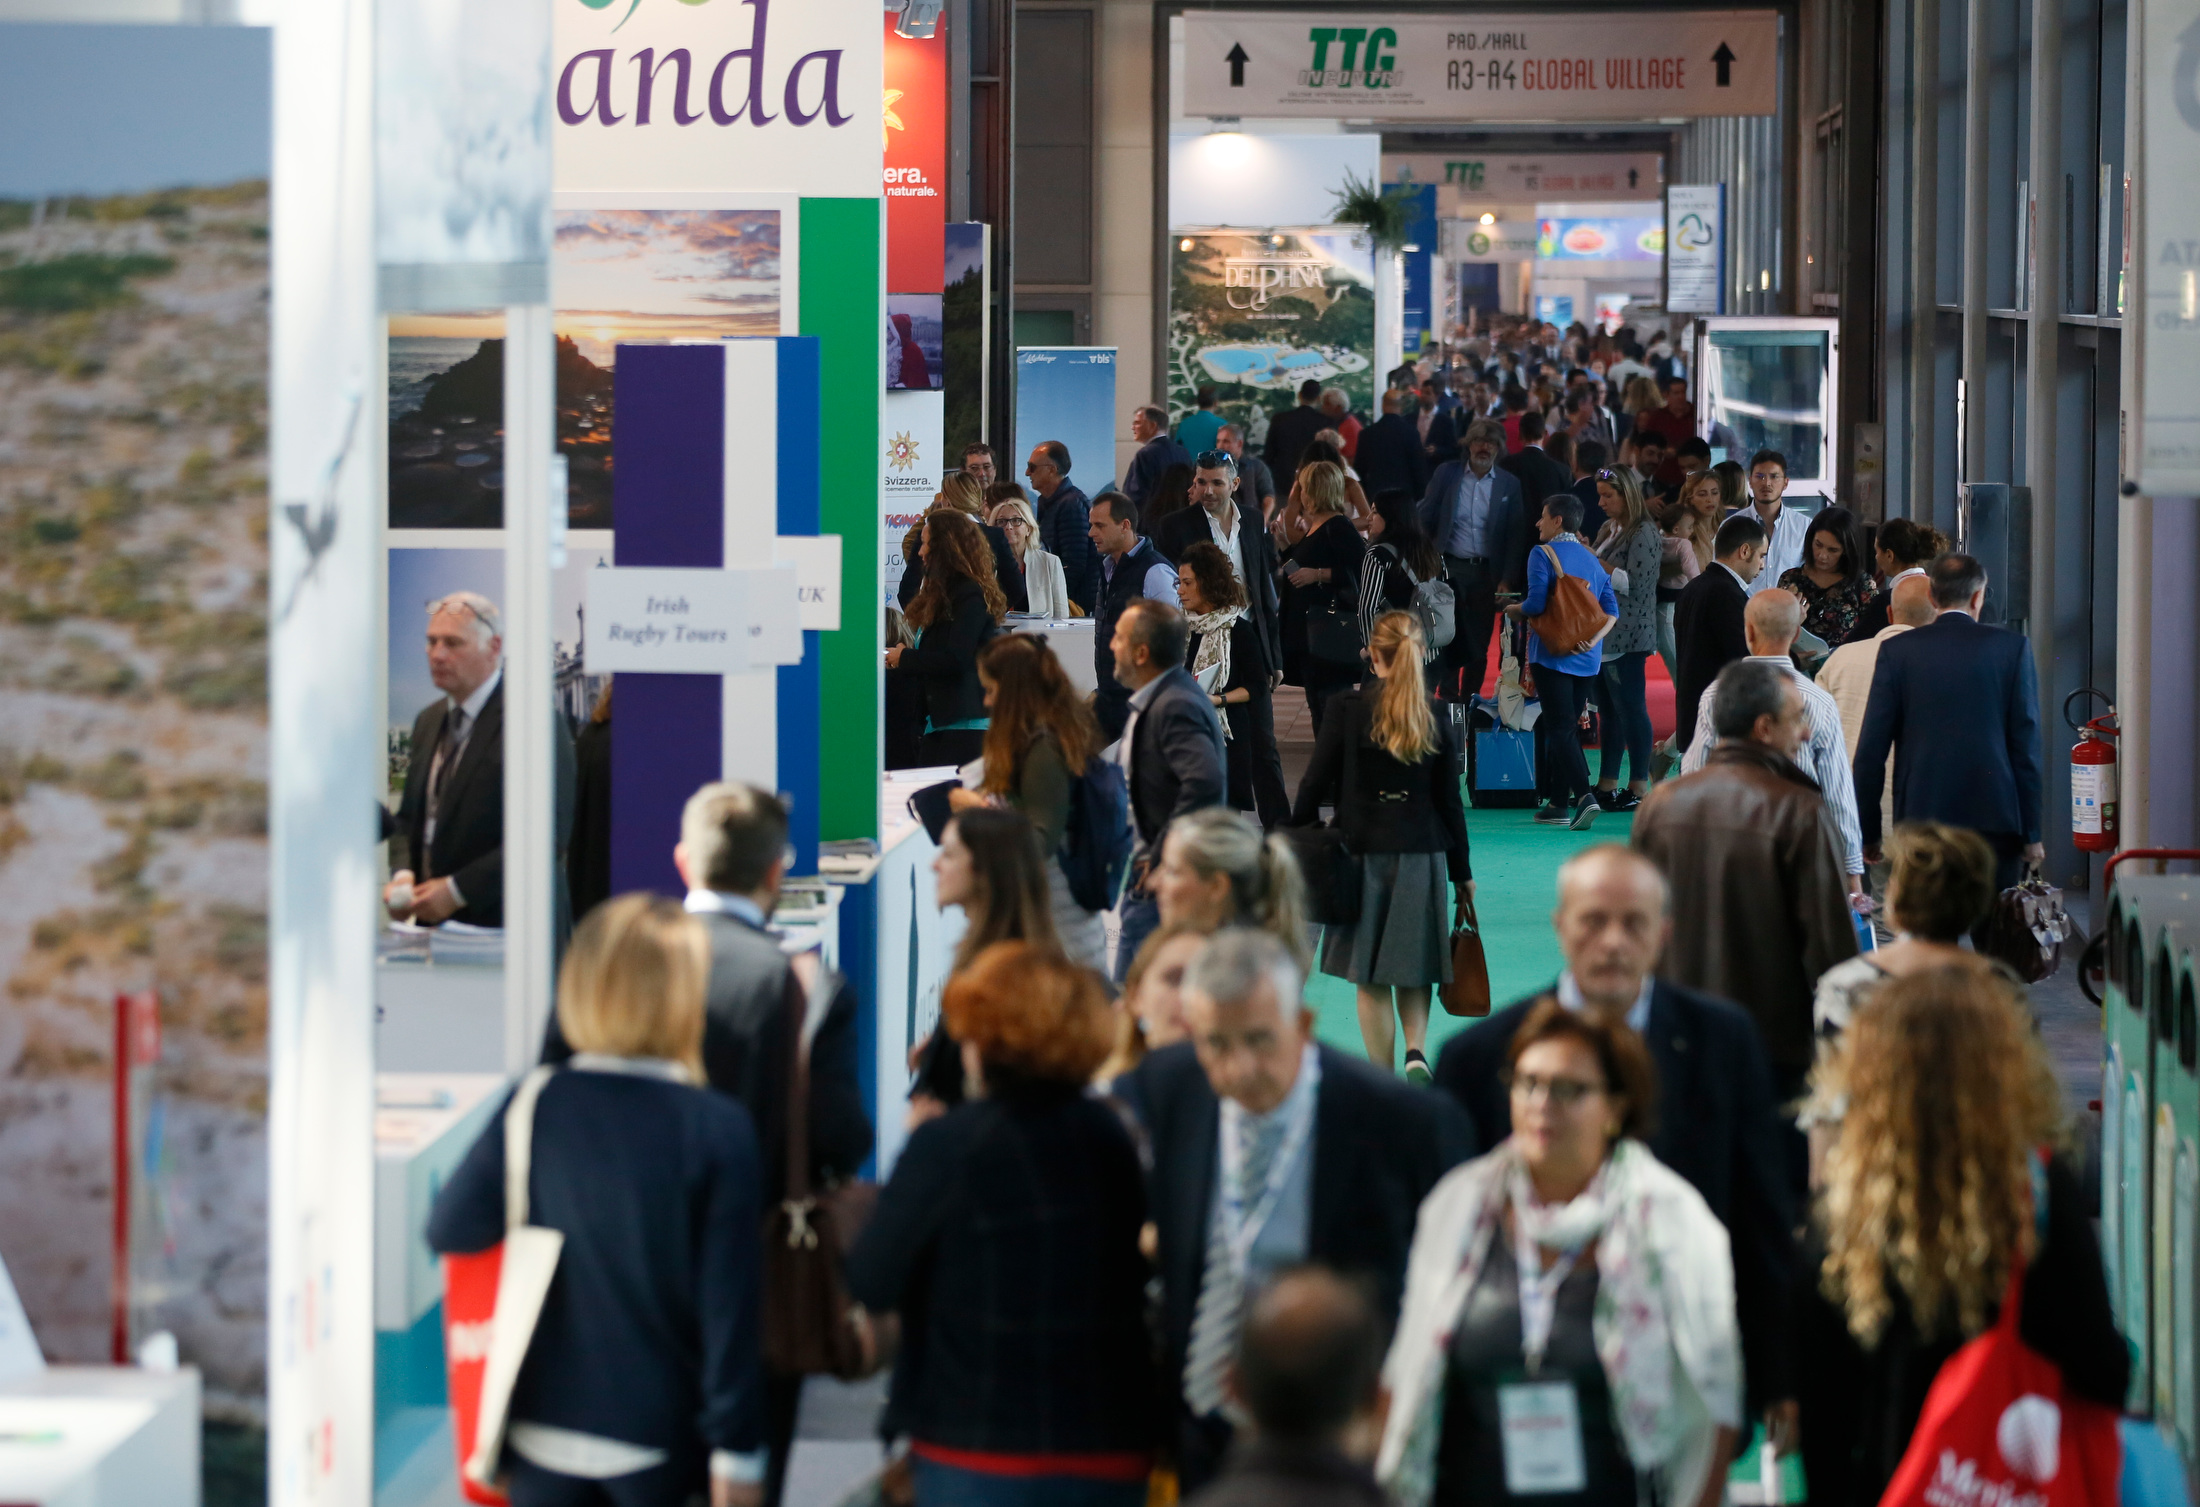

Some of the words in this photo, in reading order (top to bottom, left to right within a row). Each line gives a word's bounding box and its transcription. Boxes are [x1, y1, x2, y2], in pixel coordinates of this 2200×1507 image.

[1447, 33, 1528, 51] PAD./HALL
[1310, 27, 1398, 89] TTG
[1447, 59, 1517, 91] A3-A4
[1522, 59, 1598, 90] GLOBAL
[1606, 58, 1686, 90] VILLAGE
[882, 167, 927, 184] era.
[887, 186, 938, 197] naturale.
[798, 587, 826, 603] UK
[645, 595, 690, 615] Irish
[608, 622, 669, 647] Rugby
[674, 624, 728, 642] Tours
